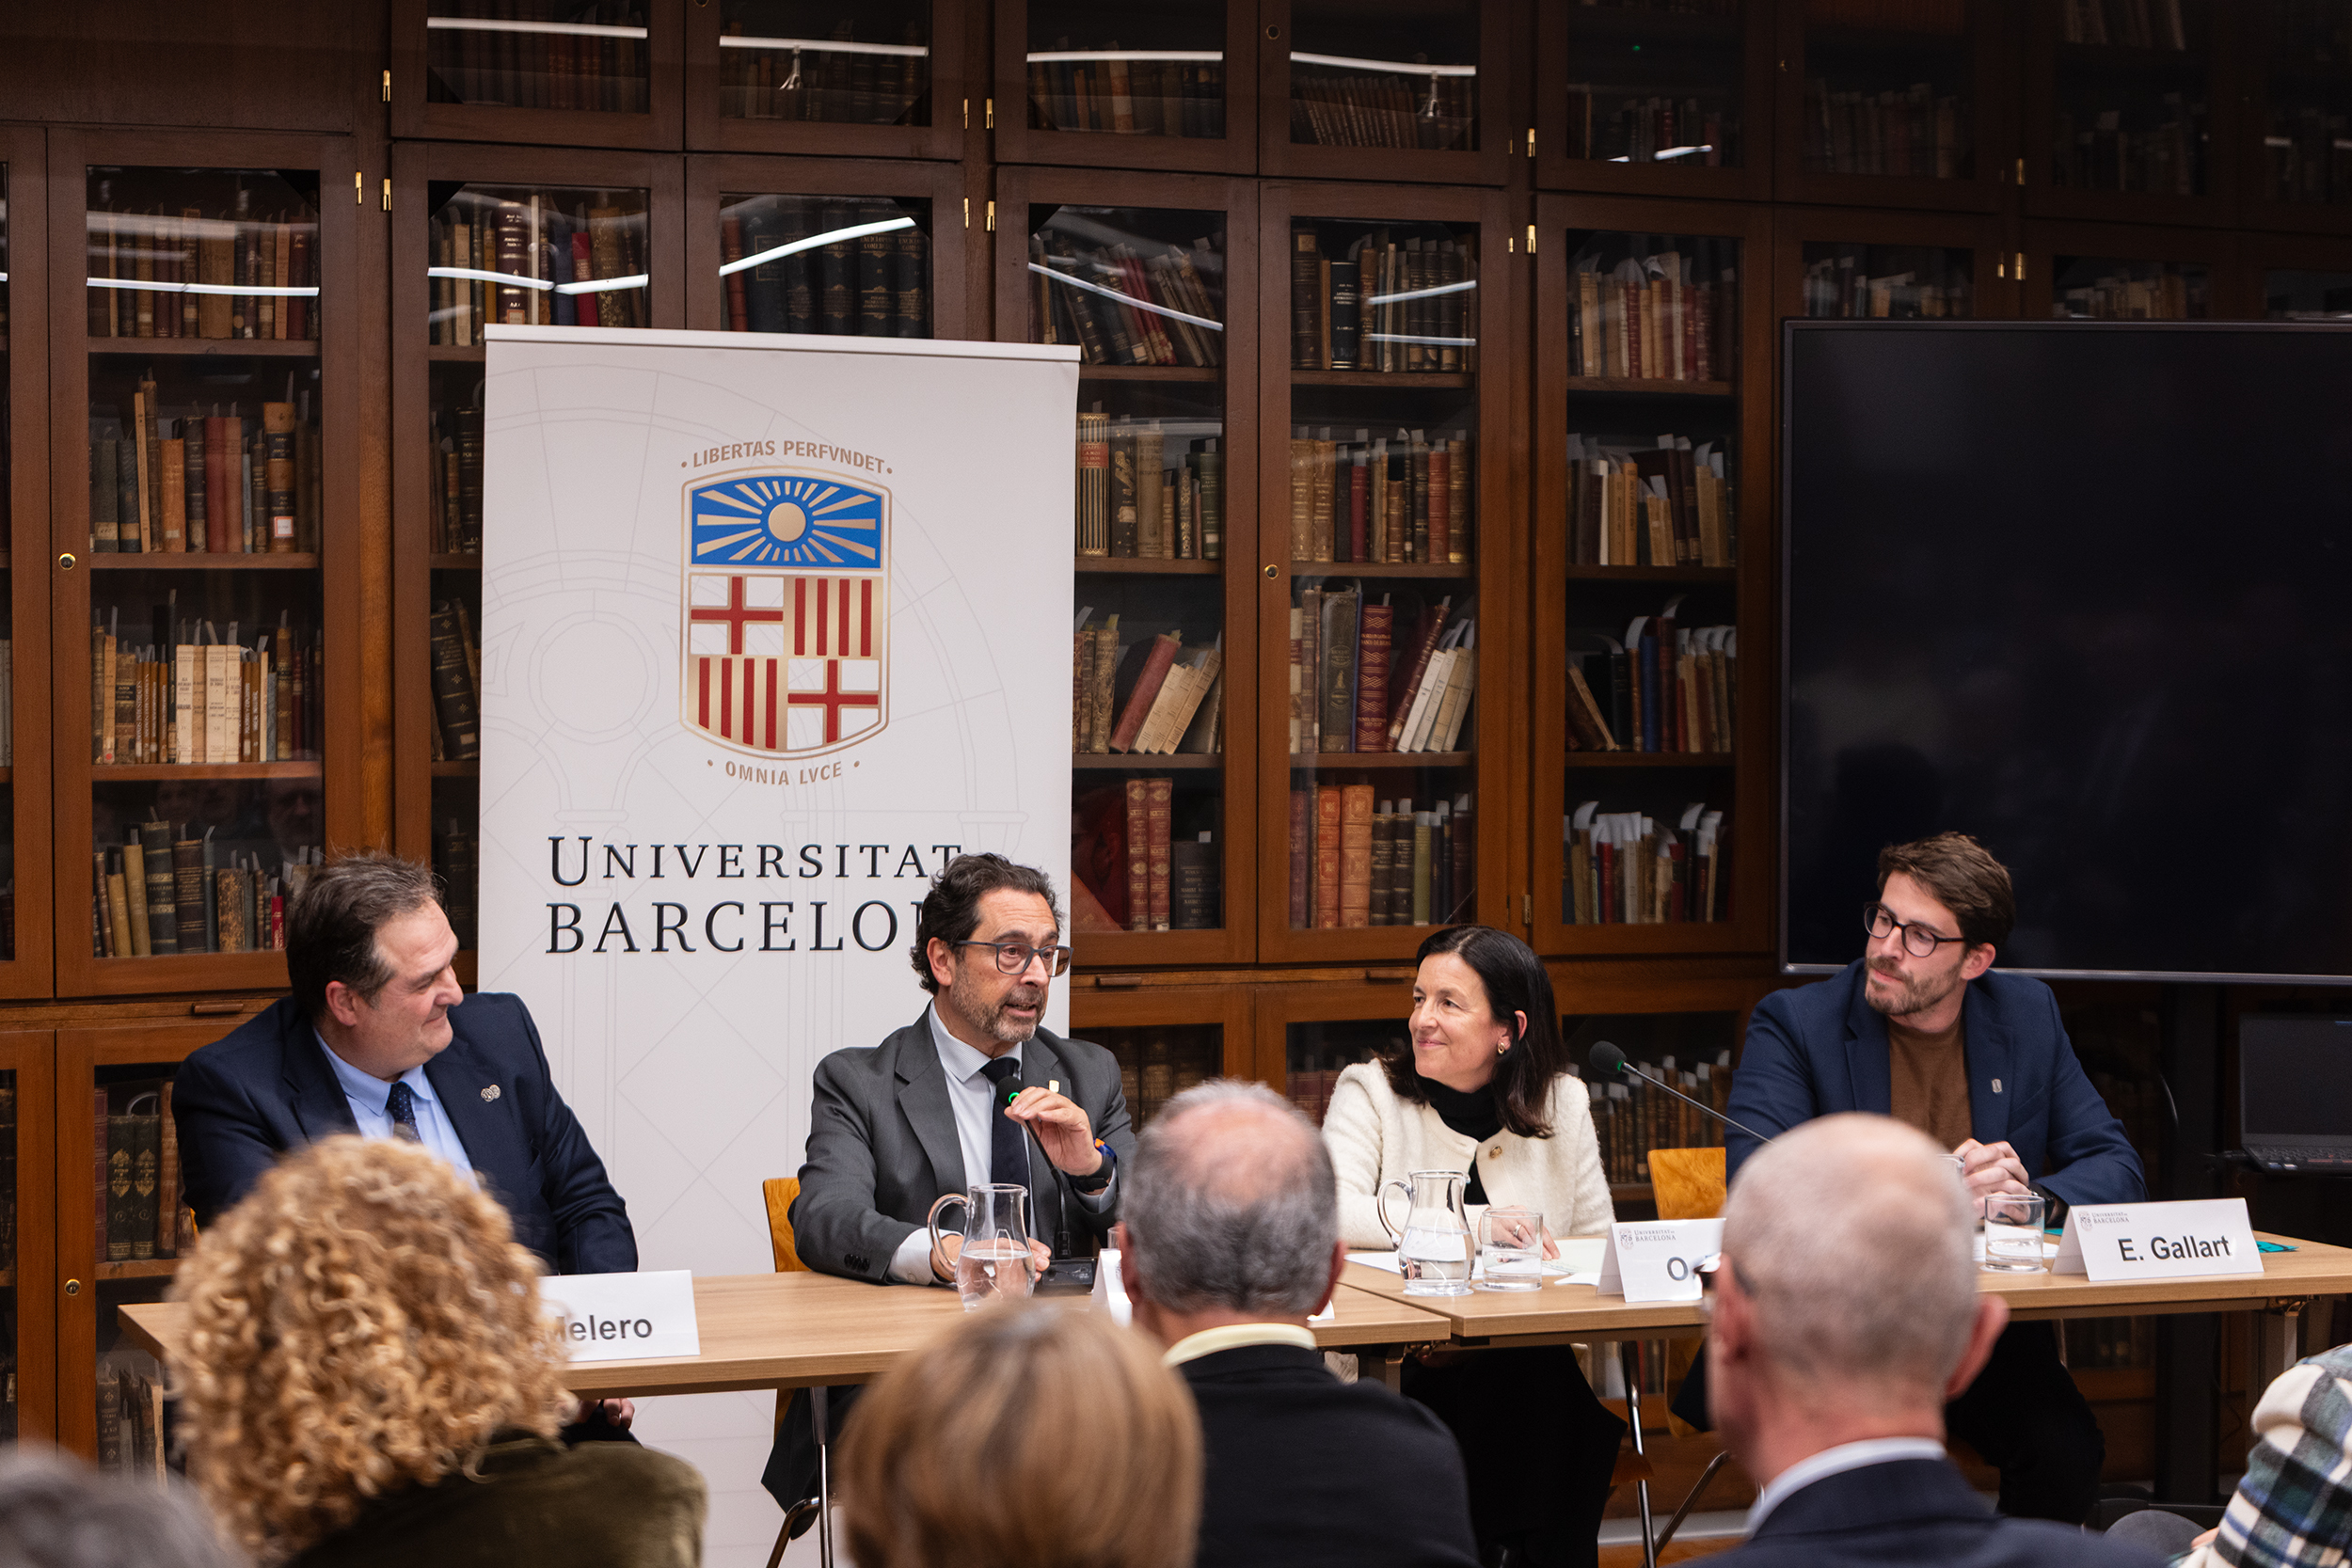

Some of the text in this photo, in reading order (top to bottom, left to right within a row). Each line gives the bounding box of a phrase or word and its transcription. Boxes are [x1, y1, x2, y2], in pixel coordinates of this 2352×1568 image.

[692, 439, 885, 474] LIBERTAS PERFVNDET
[724, 760, 842, 785] OMNIA LVCE
[548, 835, 961, 886] UNIVERSITAT
[545, 899, 924, 954] BARCELO
[2118, 1234, 2233, 1261] E. Gallart
